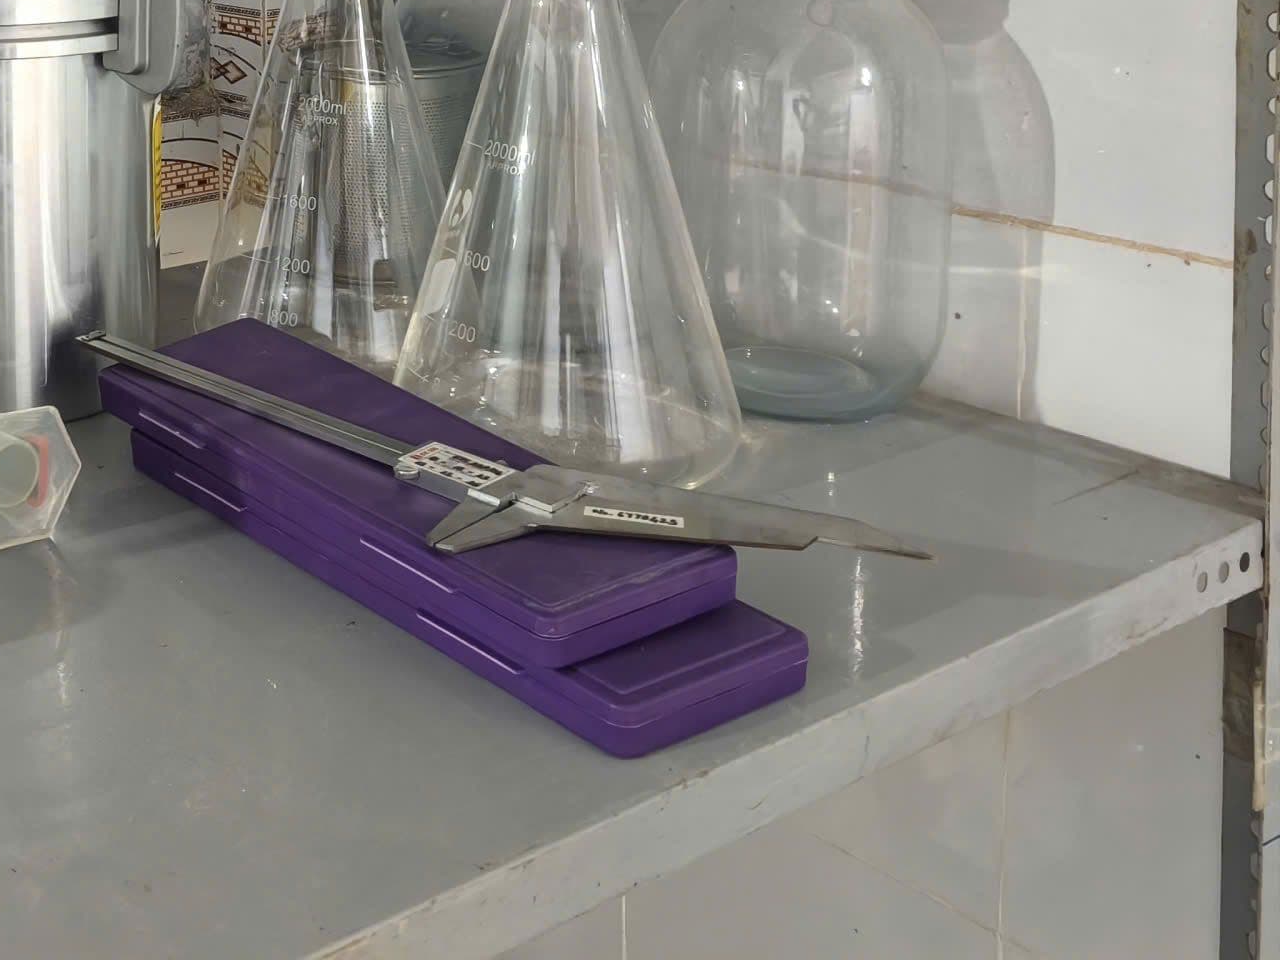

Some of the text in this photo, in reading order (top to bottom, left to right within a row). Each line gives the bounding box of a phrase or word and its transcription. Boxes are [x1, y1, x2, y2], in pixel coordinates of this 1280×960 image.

[297, 95, 347, 115] 2000ml
[484, 139, 536, 166] 2000ml
[283, 193, 317, 211] 1600
[275, 256, 310, 274] 1200
[463, 250, 491, 271] 600
[270, 310, 298, 327] 800
[447, 321, 476, 342] 200
